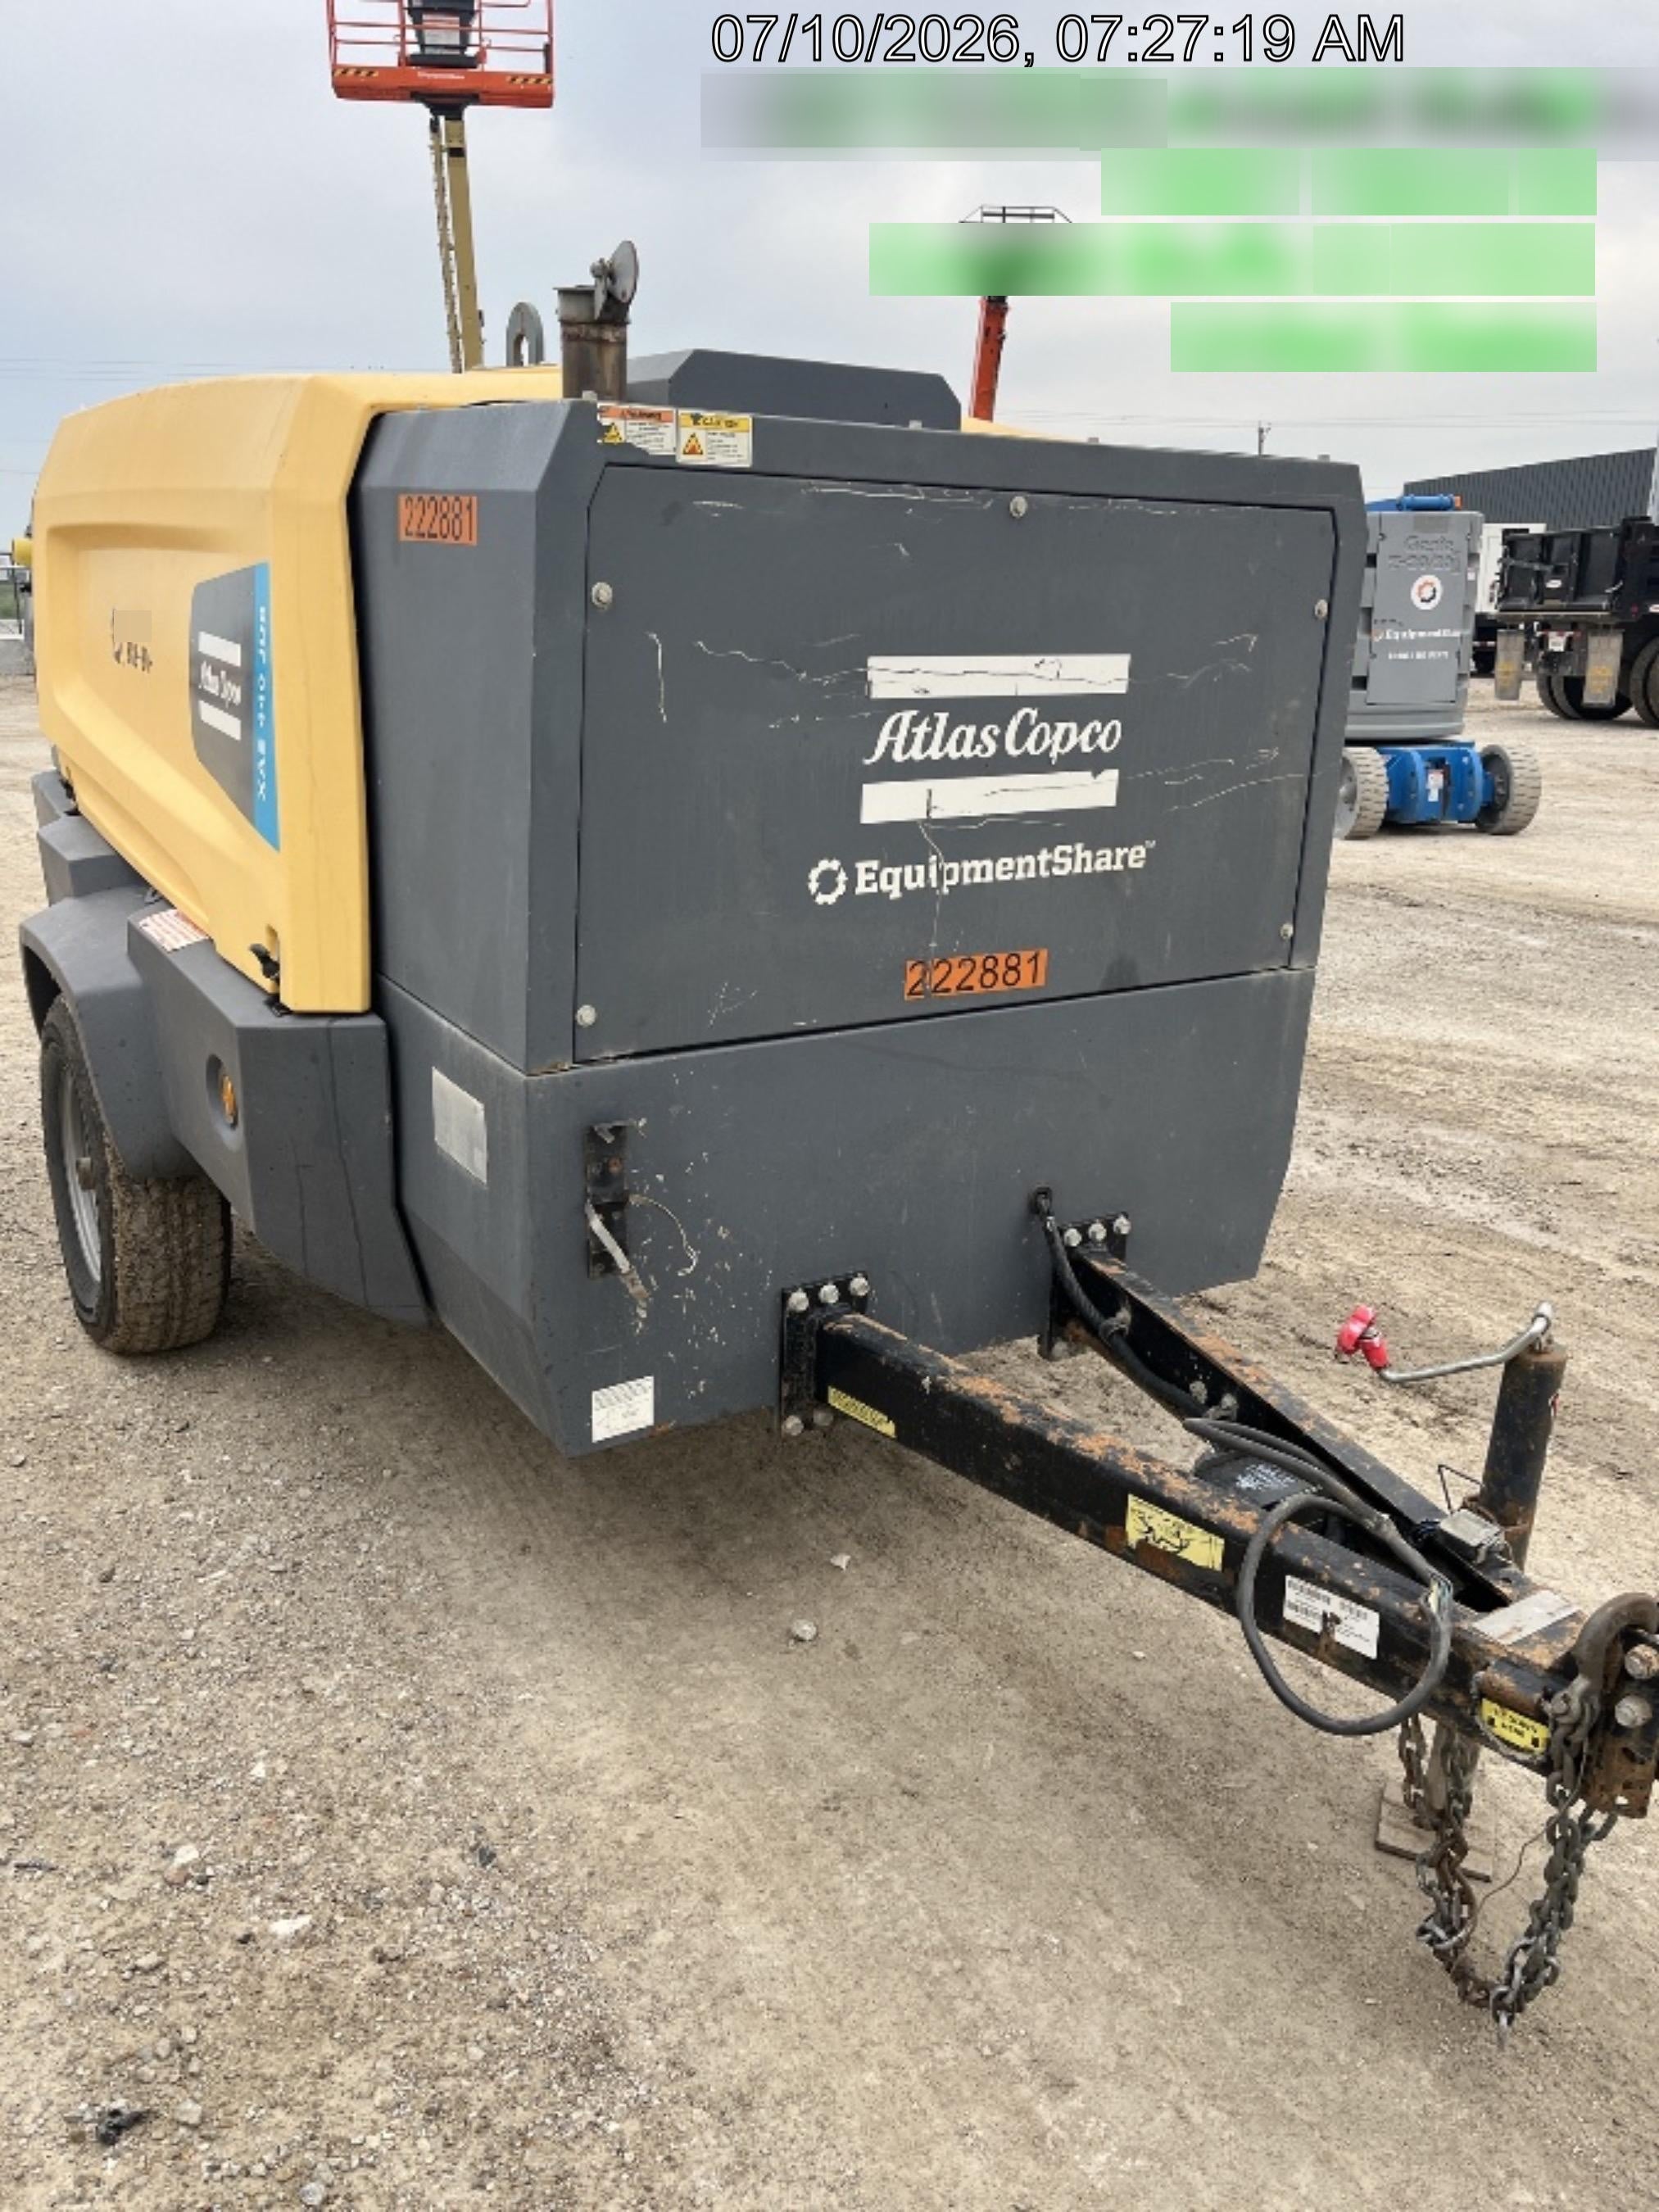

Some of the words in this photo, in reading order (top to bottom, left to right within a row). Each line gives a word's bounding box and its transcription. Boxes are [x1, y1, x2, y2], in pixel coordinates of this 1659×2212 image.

[405, 496, 473, 542] 222881
[863, 709, 1001, 765] Atlas
[1004, 707, 1122, 765] Copco
[905, 951, 1041, 997] 222881
